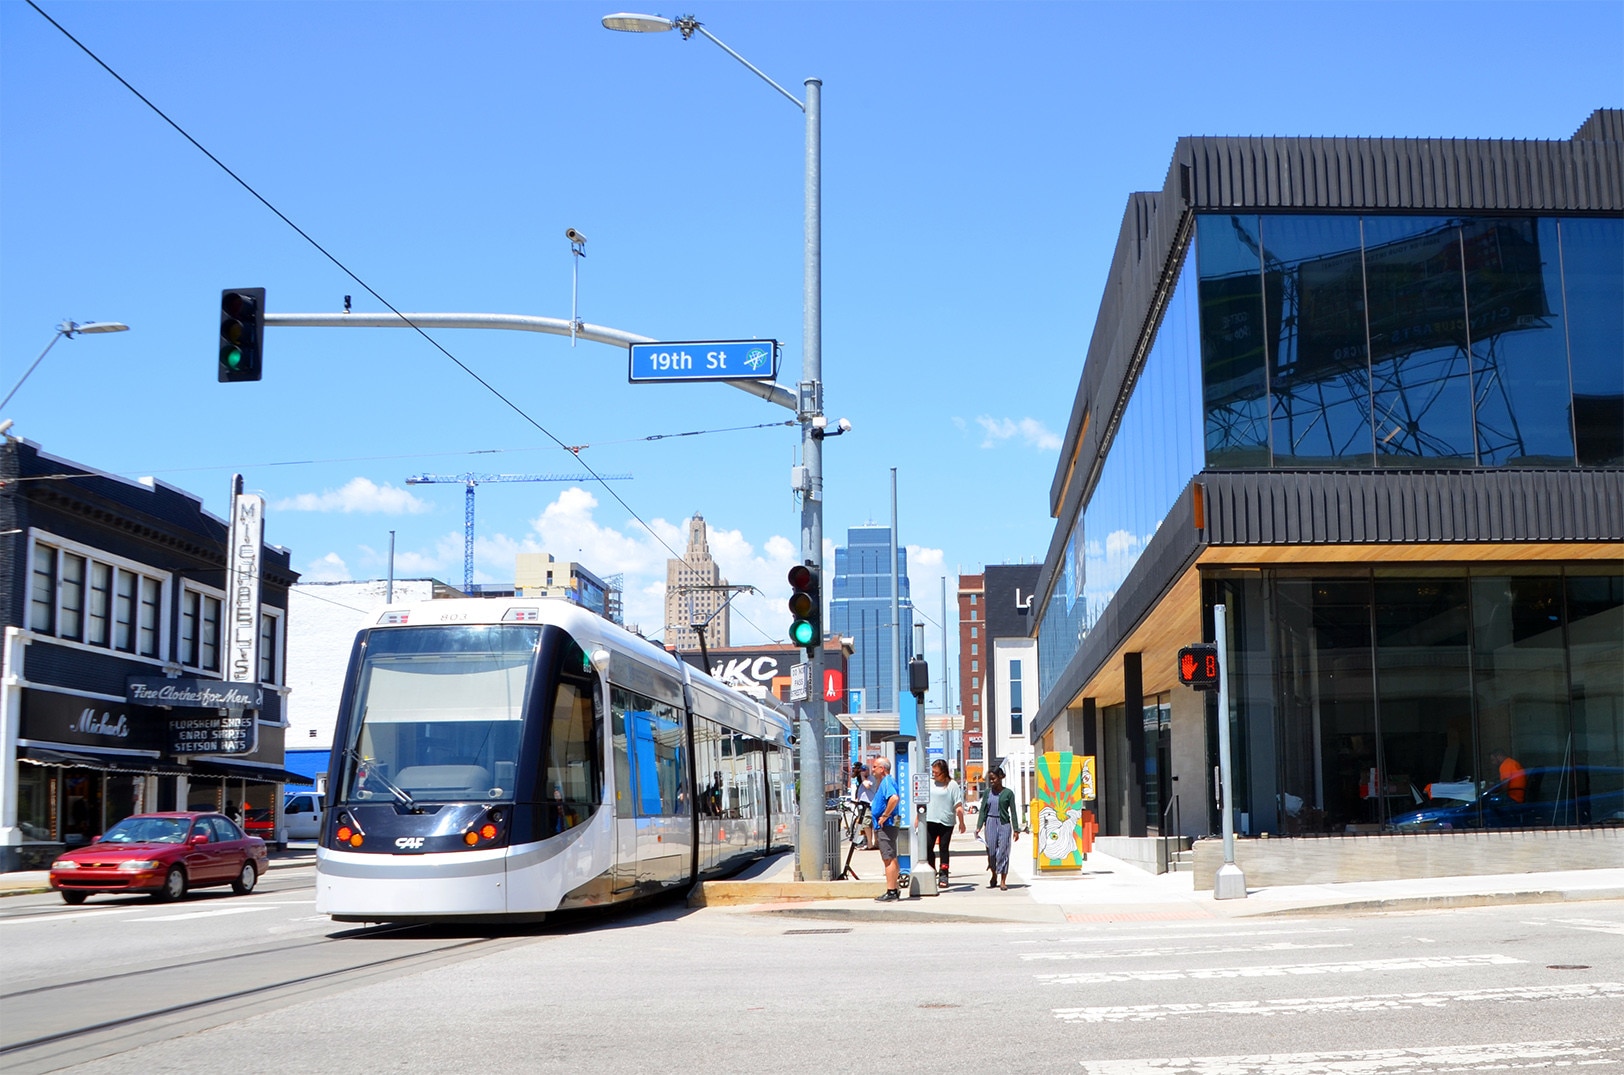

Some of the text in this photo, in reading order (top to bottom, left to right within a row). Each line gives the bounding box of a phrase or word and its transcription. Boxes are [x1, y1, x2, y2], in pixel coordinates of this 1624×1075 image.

[649, 351, 727, 370] 19th St
[130, 683, 252, 706] Fine Clothes for Men
[169, 717, 252, 730] FLORSHEIM SHOES
[179, 729, 246, 740] ENRO SHIRTS
[174, 740, 246, 752] STETSON HATS
[394, 837, 425, 849] CAF
